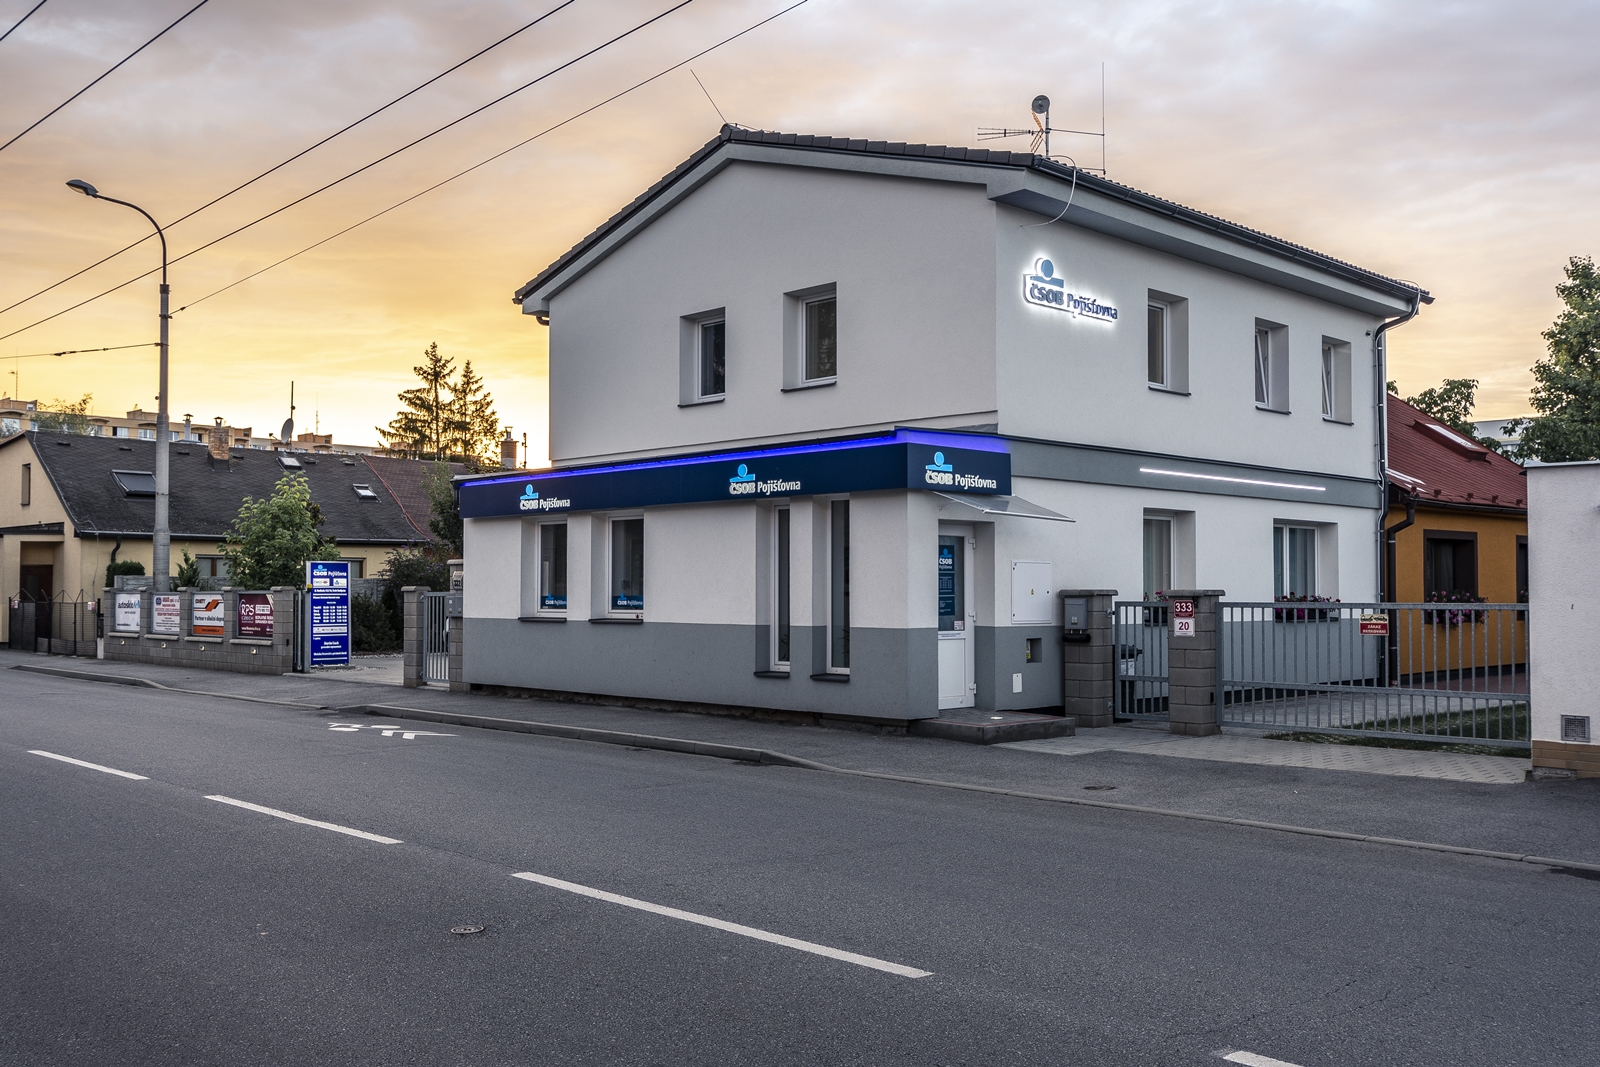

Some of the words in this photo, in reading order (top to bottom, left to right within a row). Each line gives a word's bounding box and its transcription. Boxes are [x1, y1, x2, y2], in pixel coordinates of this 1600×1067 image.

[1030, 283, 1064, 305] ČSOB
[1067, 293, 1118, 320] Pojišťovna
[925, 470, 953, 485] ČSOB
[955, 473, 997, 490] Pojišťovna
[729, 482, 756, 495] ČSOB
[757, 479, 801, 496] Pojišťovna
[520, 499, 538, 510] ČSOB
[540, 497, 570, 511] Pojišťovna
[241, 604, 255, 615] RPS
[1175, 602, 1192, 612] 333
[1178, 621, 1189, 631] 20
